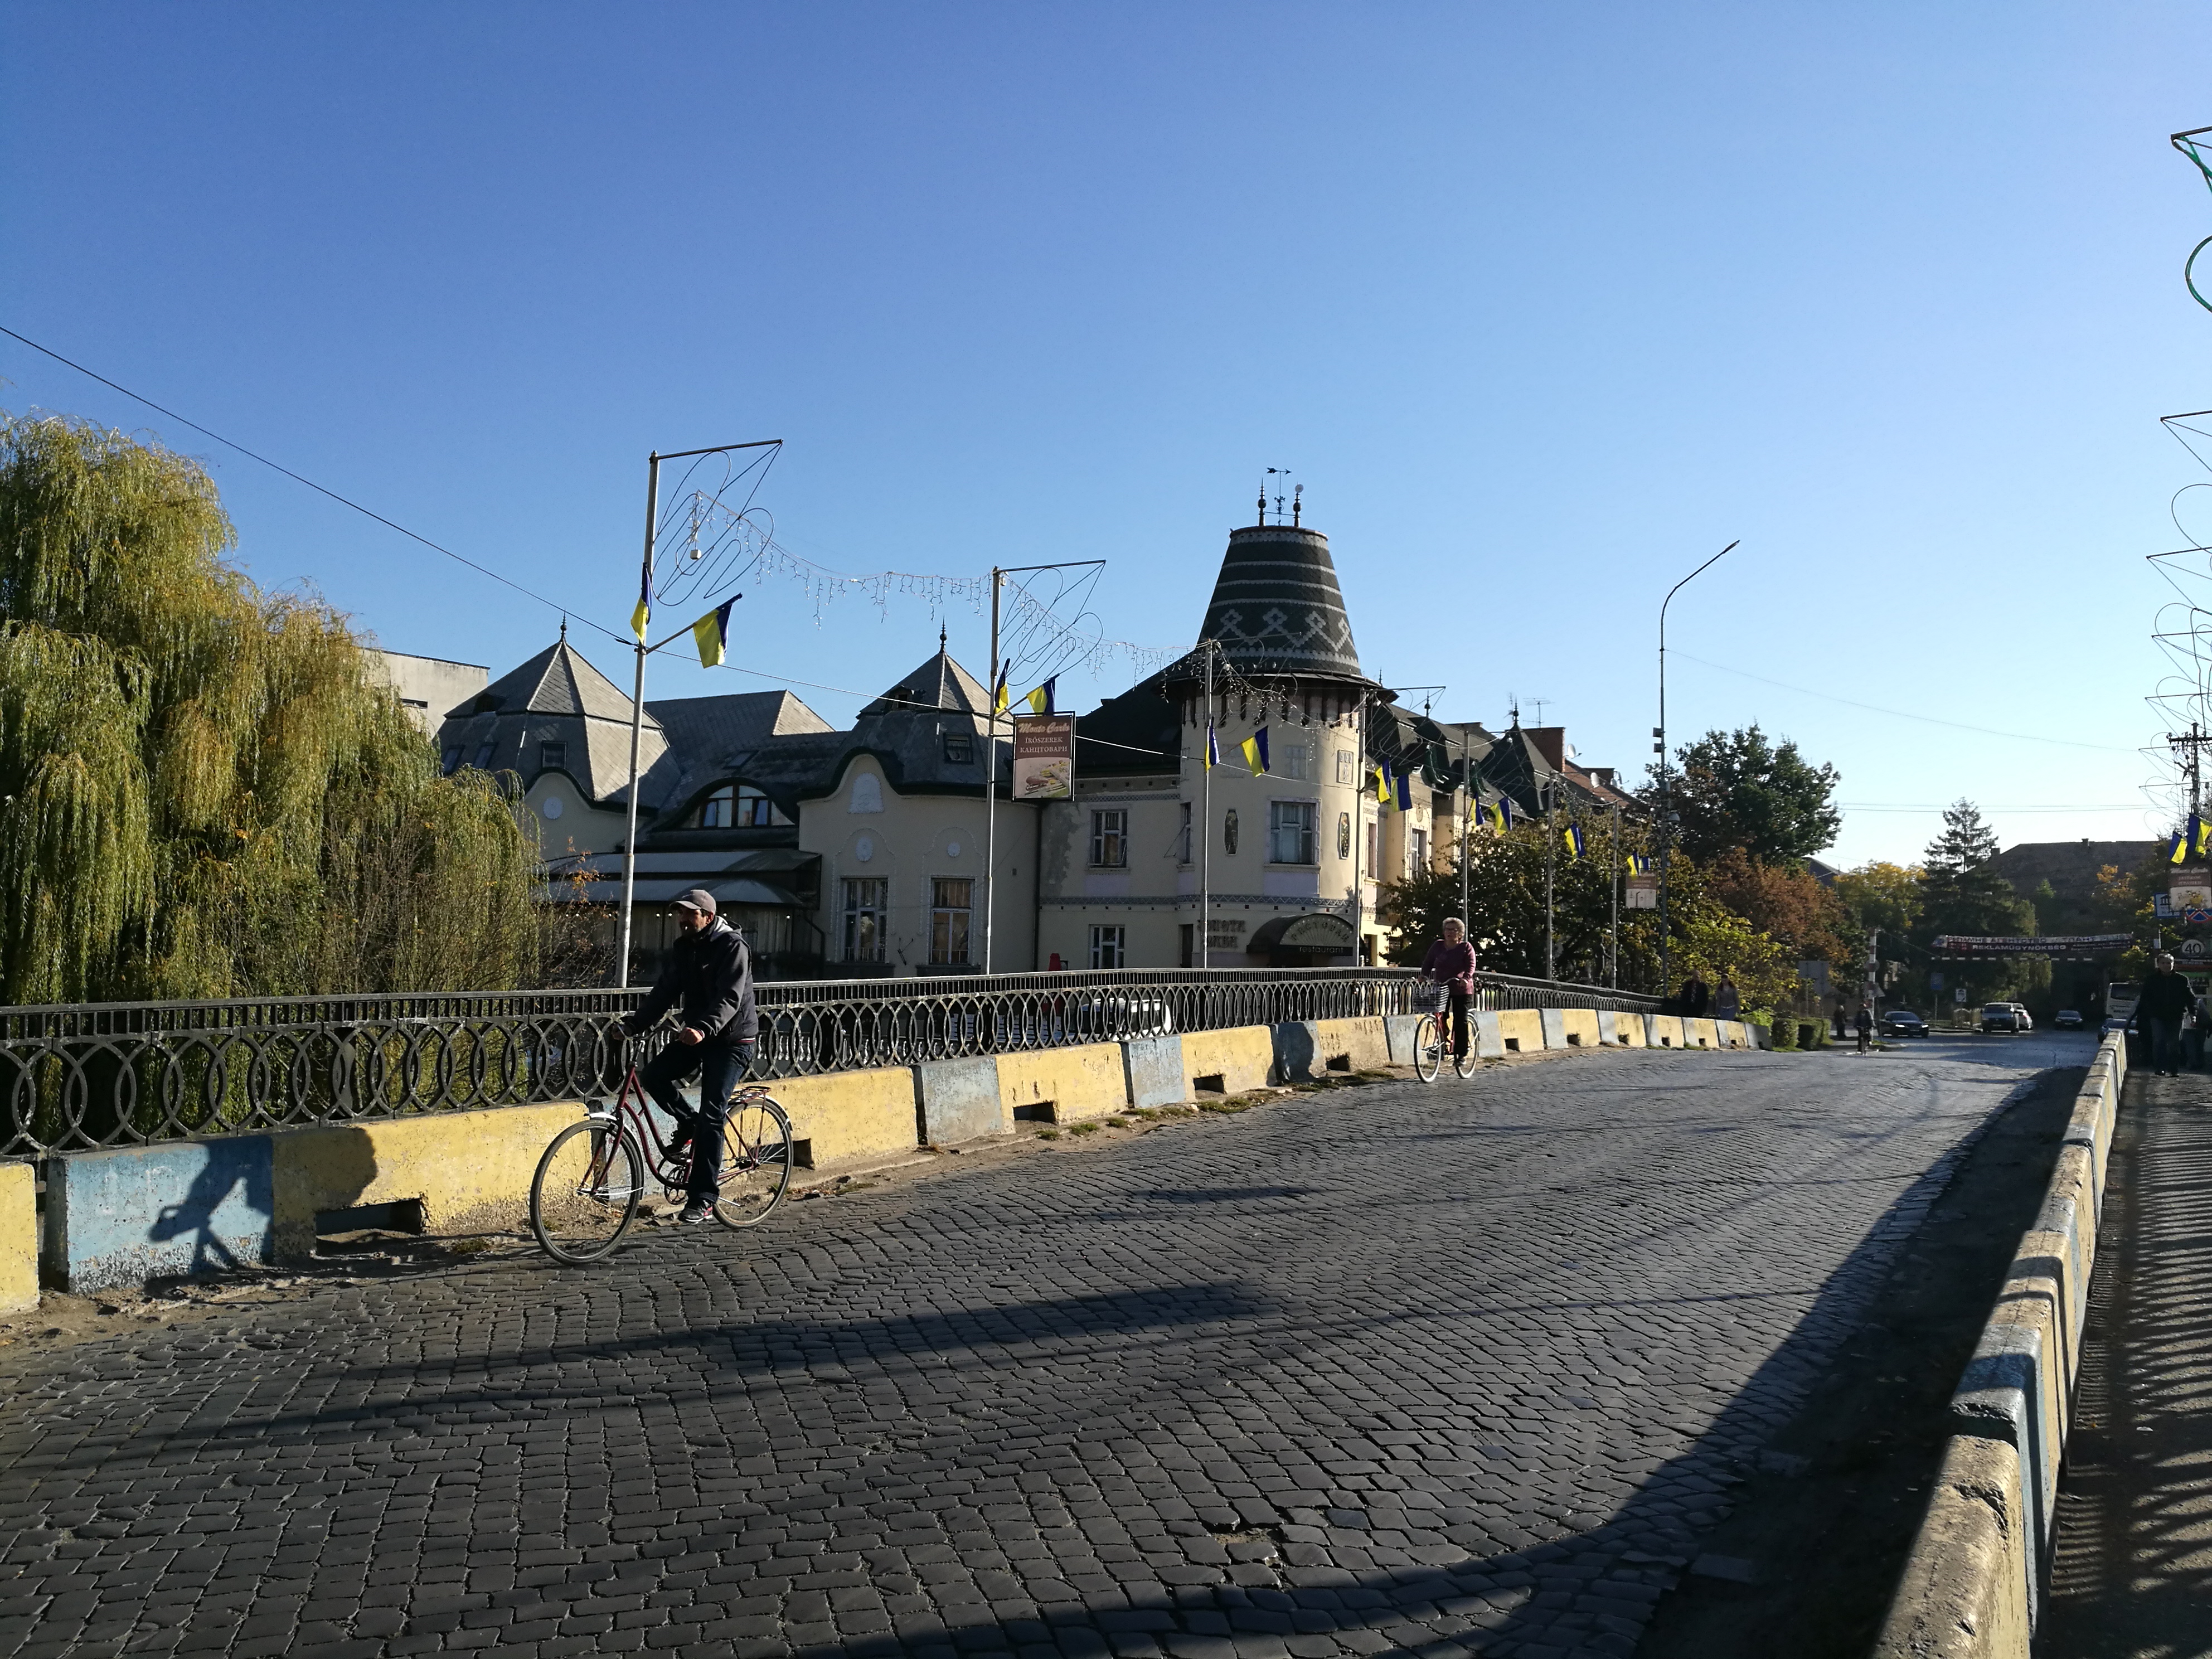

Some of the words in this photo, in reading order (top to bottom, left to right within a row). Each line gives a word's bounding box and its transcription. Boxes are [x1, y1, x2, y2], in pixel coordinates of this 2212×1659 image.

[1017, 722, 1046, 734] Monte
[1046, 721, 1070, 734] Carlo
[2185, 943, 2201, 953] 40
